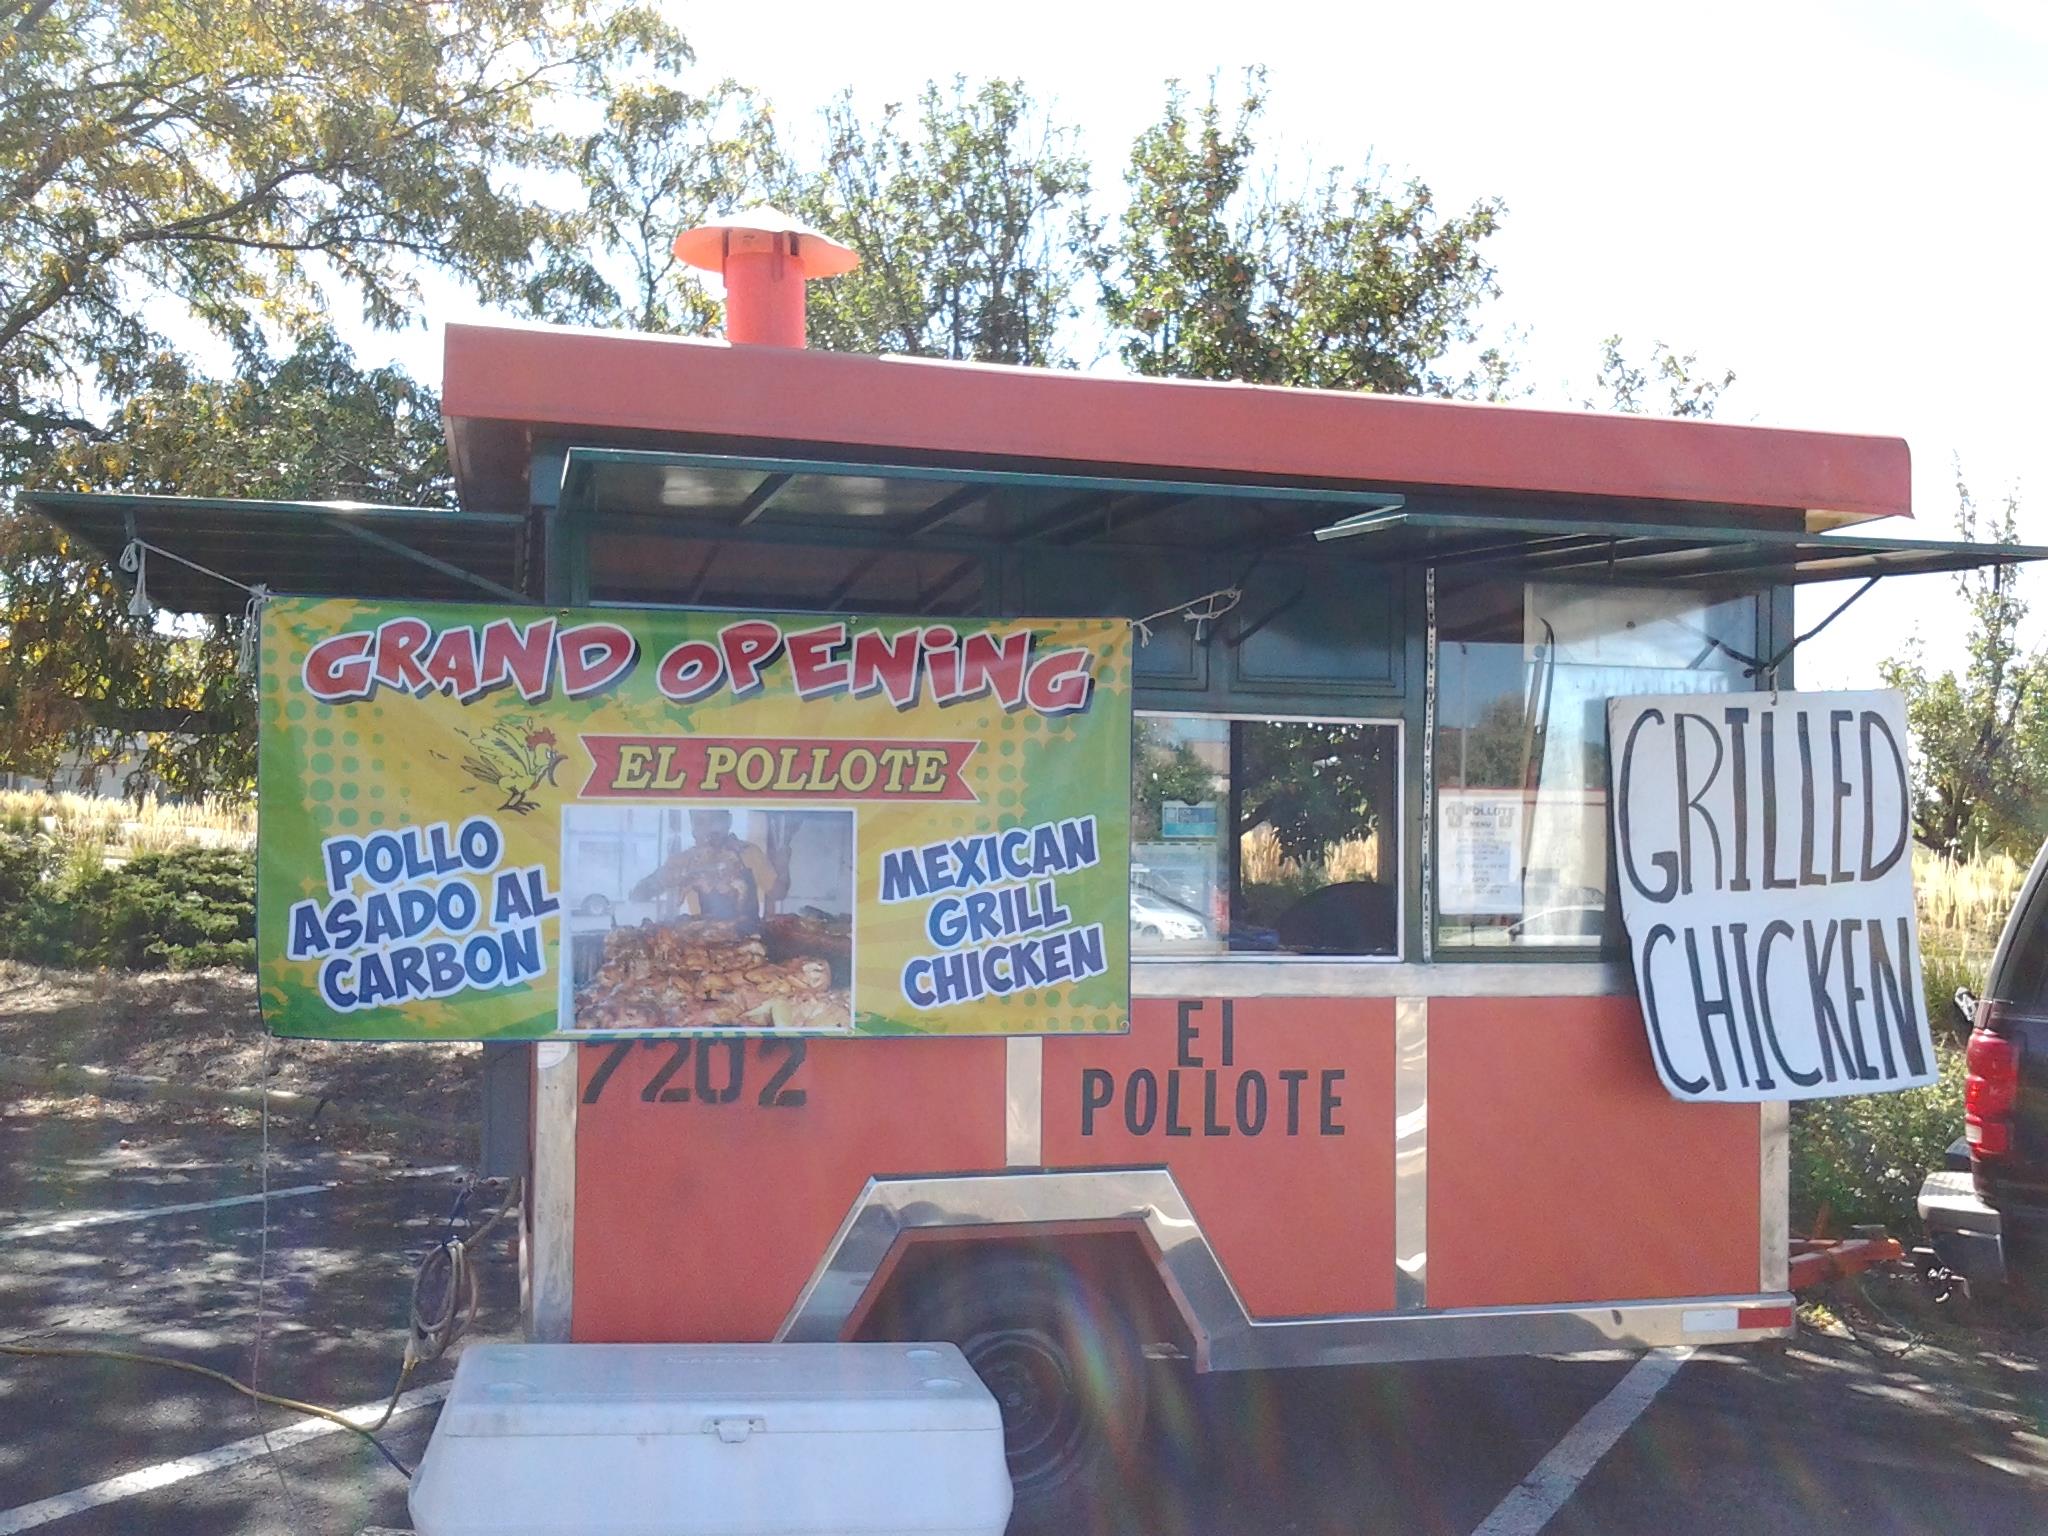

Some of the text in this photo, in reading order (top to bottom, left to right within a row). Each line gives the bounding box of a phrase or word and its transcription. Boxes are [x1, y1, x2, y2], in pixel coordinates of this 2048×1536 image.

[303, 617, 1093, 714] GRAND OPENING
[611, 745, 948, 793] EL POLLOTE
[1619, 708, 1909, 904] GRILLED
[326, 820, 500, 893] POLLO
[882, 818, 1098, 900] MEXICAN
[291, 868, 559, 957] ASADO AL
[929, 882, 1068, 947] GRILL
[323, 926, 542, 1008] CARBON
[904, 927, 1106, 1008] CHICKEN
[1642, 917, 1928, 1095] CHICKEN
[582, 1038, 808, 1106] 7202
[1081, 1068, 1346, 1137] POLLOTE
